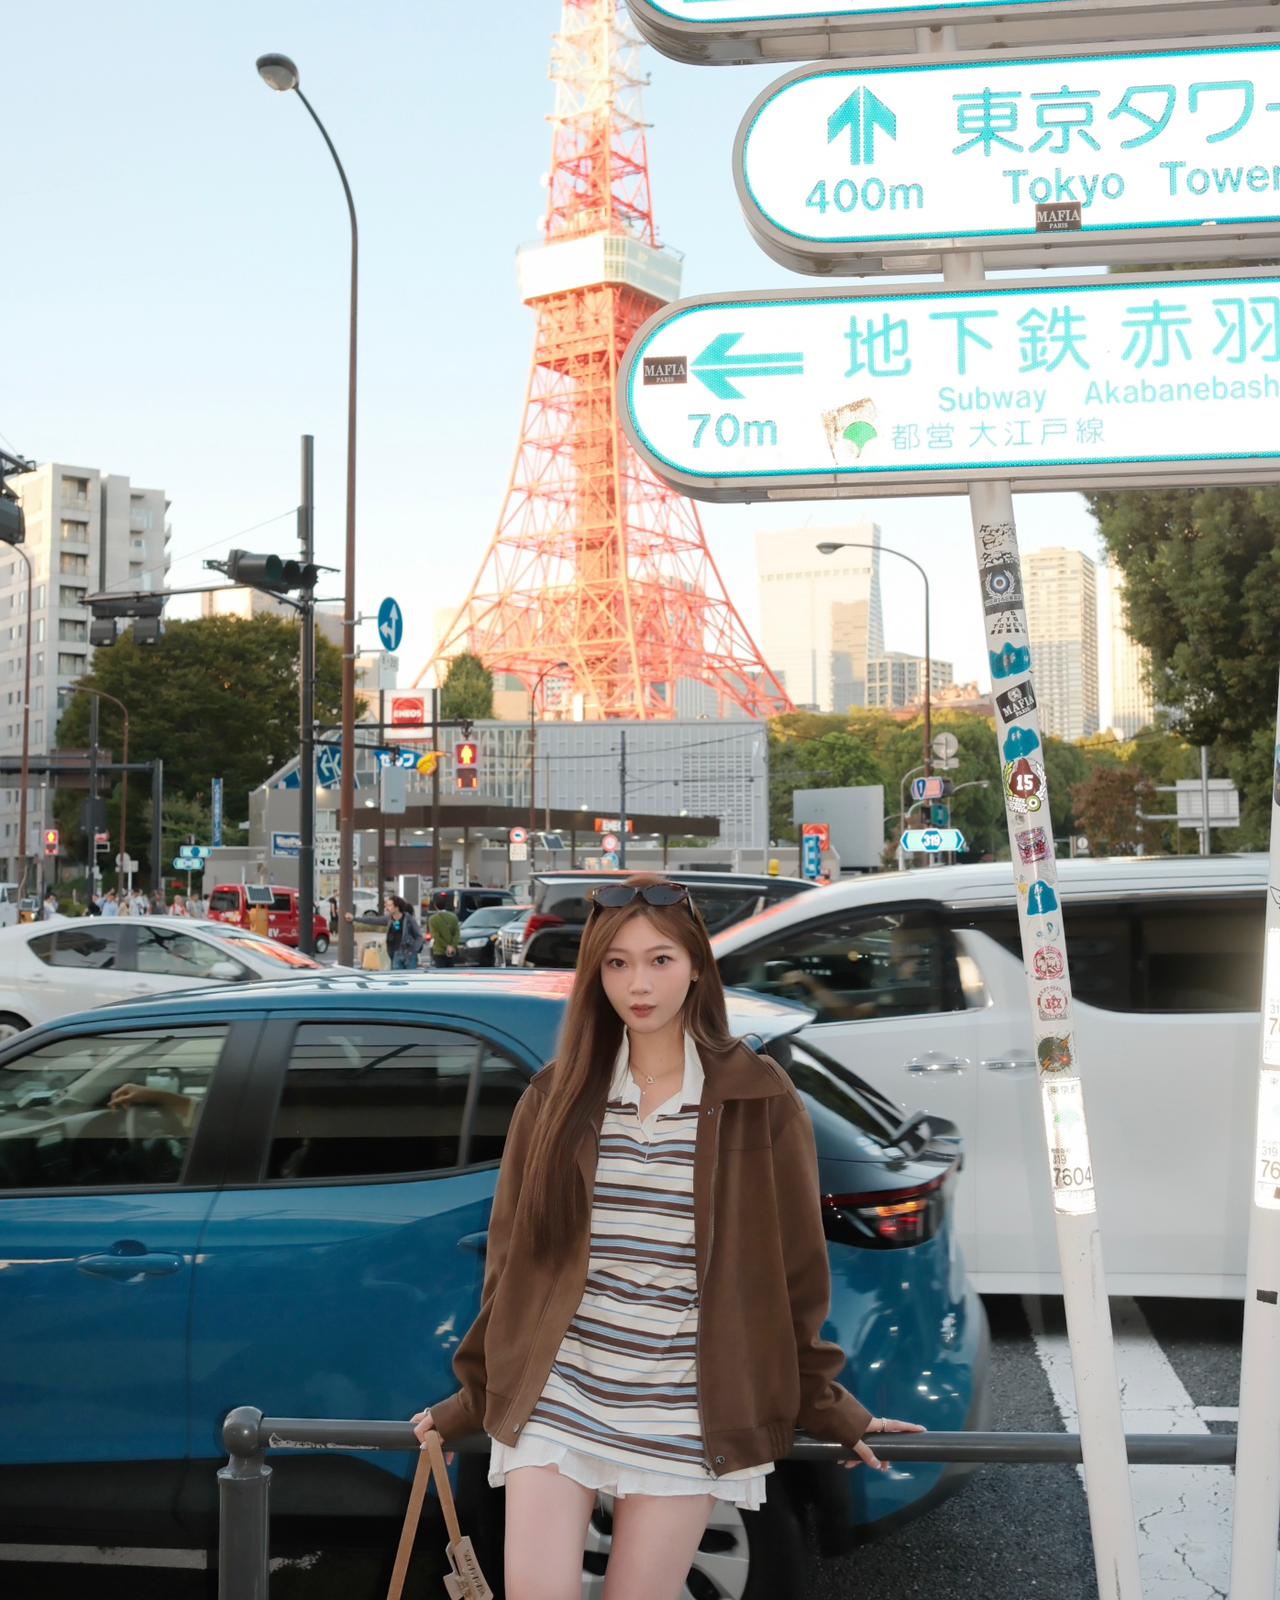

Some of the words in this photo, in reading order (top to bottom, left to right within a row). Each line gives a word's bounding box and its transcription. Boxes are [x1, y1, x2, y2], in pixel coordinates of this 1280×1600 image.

[952, 80, 1280, 157] 東京タワ
[805, 176, 924, 214] 400m
[1002, 167, 1125, 208] Tokyo
[1036, 209, 1080, 223] MAFIA
[644, 363, 685, 377] MAFIA
[938, 386, 1046, 413] Subway
[1084, 373, 1280, 405] Akabanebash
[688, 413, 777, 448] 70m
[393, 709, 422, 718] ENEOS
[1003, 695, 1035, 717] MAFIA
[1016, 774, 1034, 791] 15
[923, 834, 941, 847] 319
[1053, 1166, 1092, 1187] 7604
